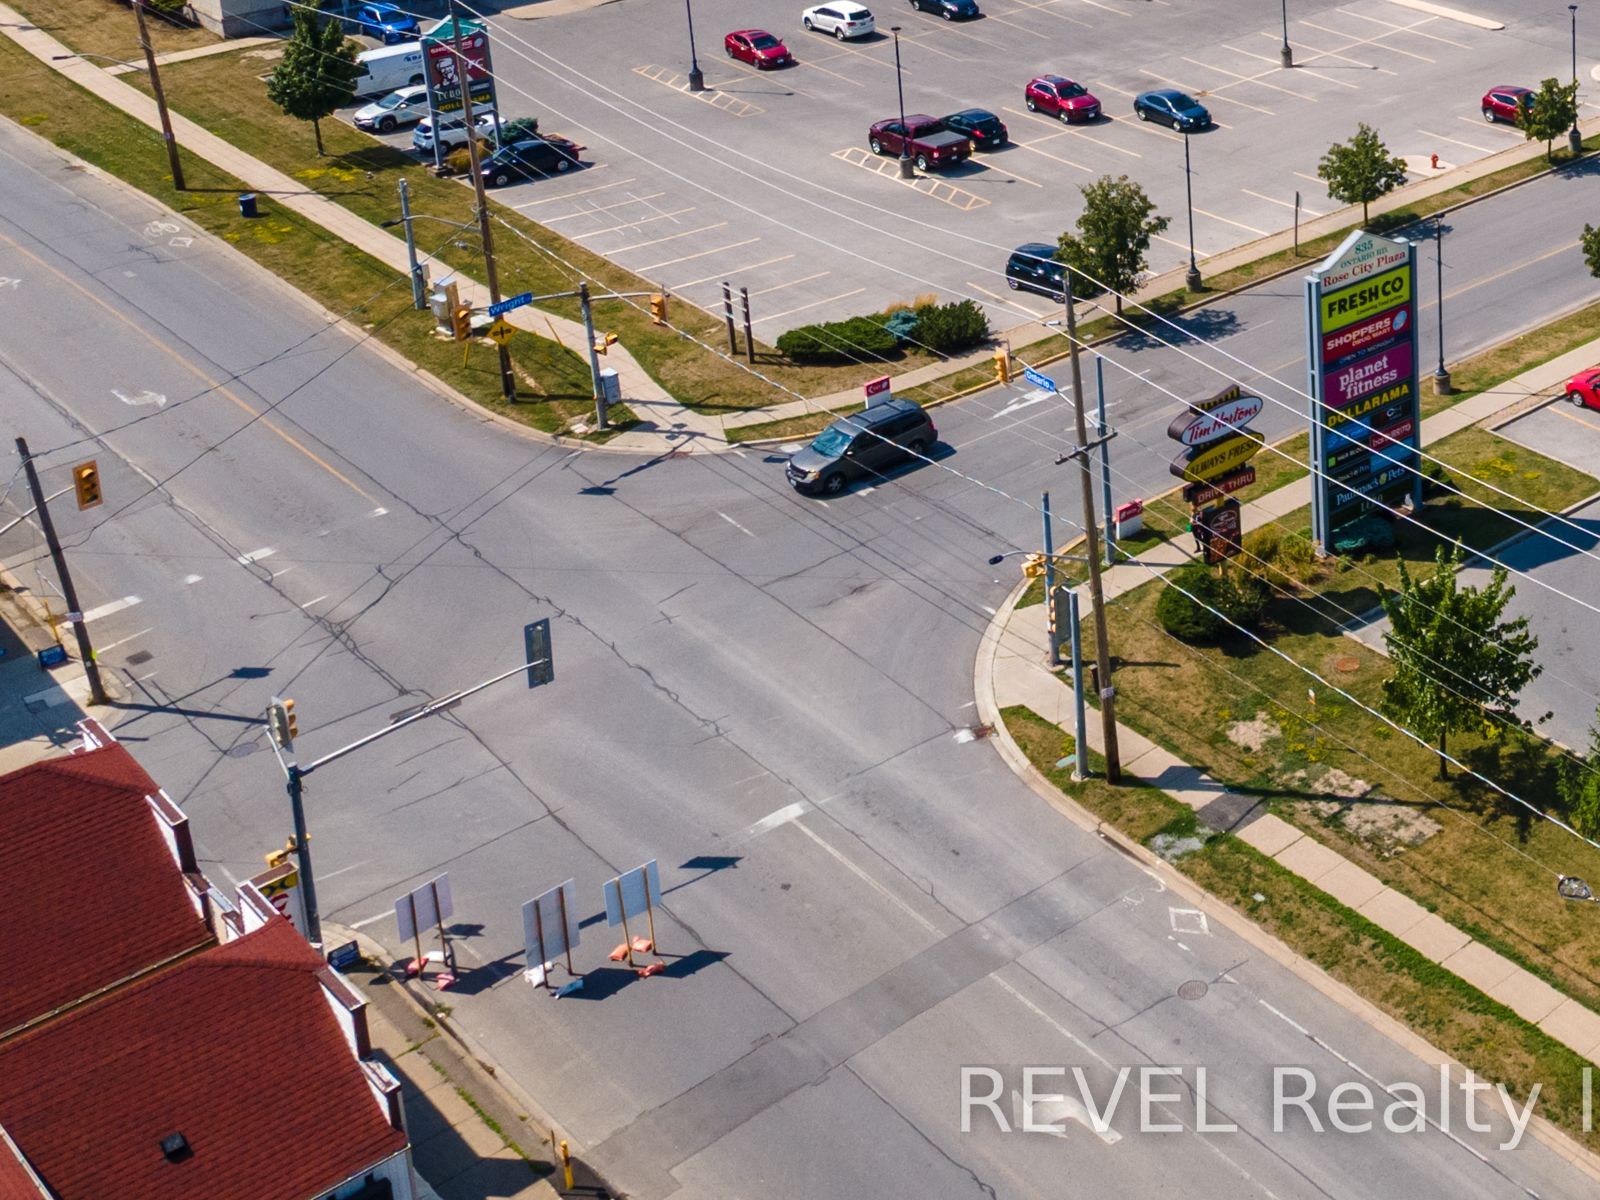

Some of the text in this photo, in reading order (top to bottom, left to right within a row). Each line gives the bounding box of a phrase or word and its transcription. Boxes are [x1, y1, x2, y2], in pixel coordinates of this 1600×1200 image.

[1340, 251, 1376, 268] ONTARIO
[1354, 240, 1373, 255] 835
[1323, 251, 1406, 287] Rose City Plaza
[490, 296, 525, 314] Wright
[1326, 318, 1391, 351] SHOPPERS
[1352, 335, 1372, 347] DRUG
[1026, 370, 1050, 388] Ontario
[1339, 355, 1388, 391] planet
[1346, 369, 1398, 399] fitness
[1327, 384, 1409, 428] DOLLARAMA
[1189, 404, 1257, 442] Tim Hortons
[1190, 452, 1226, 475] ALWAYS
[1388, 467, 1406, 481] Pets
[1198, 471, 1253, 503] DRIVE THRU
